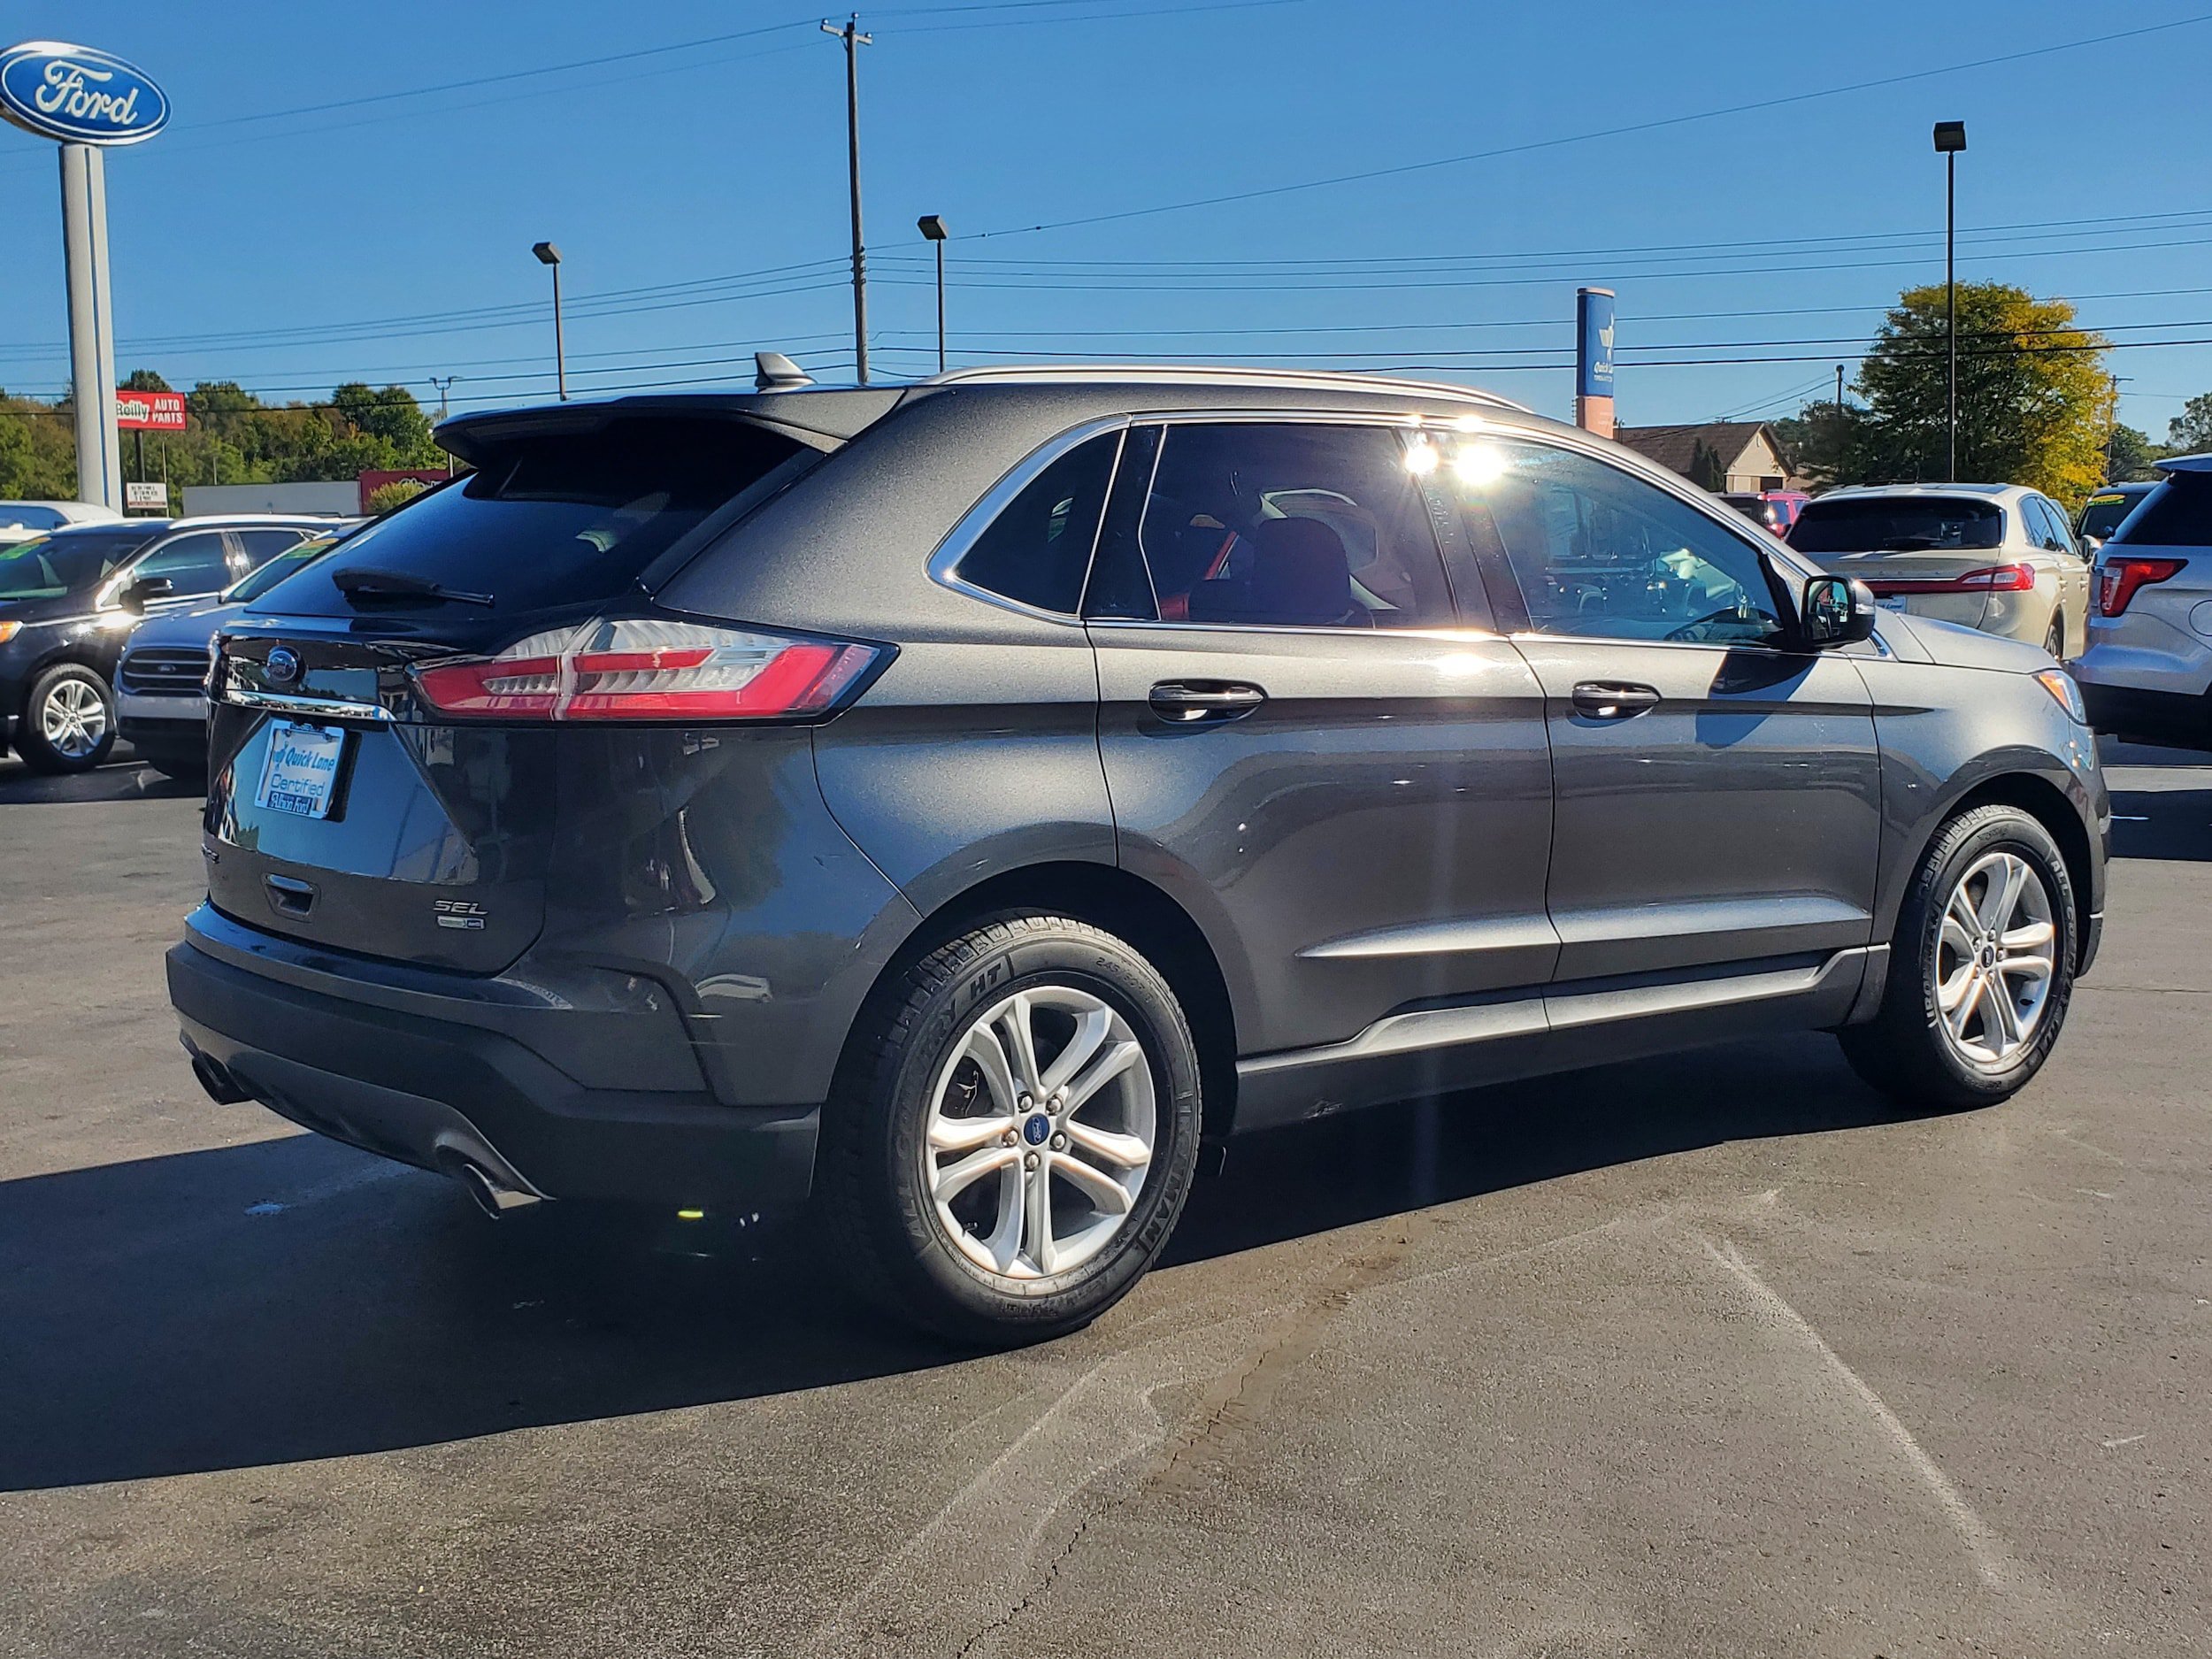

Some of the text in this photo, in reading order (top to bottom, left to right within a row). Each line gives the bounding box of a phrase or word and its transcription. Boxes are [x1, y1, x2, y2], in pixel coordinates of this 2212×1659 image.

[35, 59, 138, 125] Ford
[155, 398, 180, 411] AUTO
[152, 412, 182, 424] PARTS
[285, 747, 335, 772] Quick Lane
[271, 773, 325, 796] Certified
[293, 795, 311, 813] Ford
[2049, 860, 2069, 896] ALL
[433, 900, 488, 915] SEL
[898, 1186, 927, 1238] ALL
[970, 963, 1002, 1000] HT
